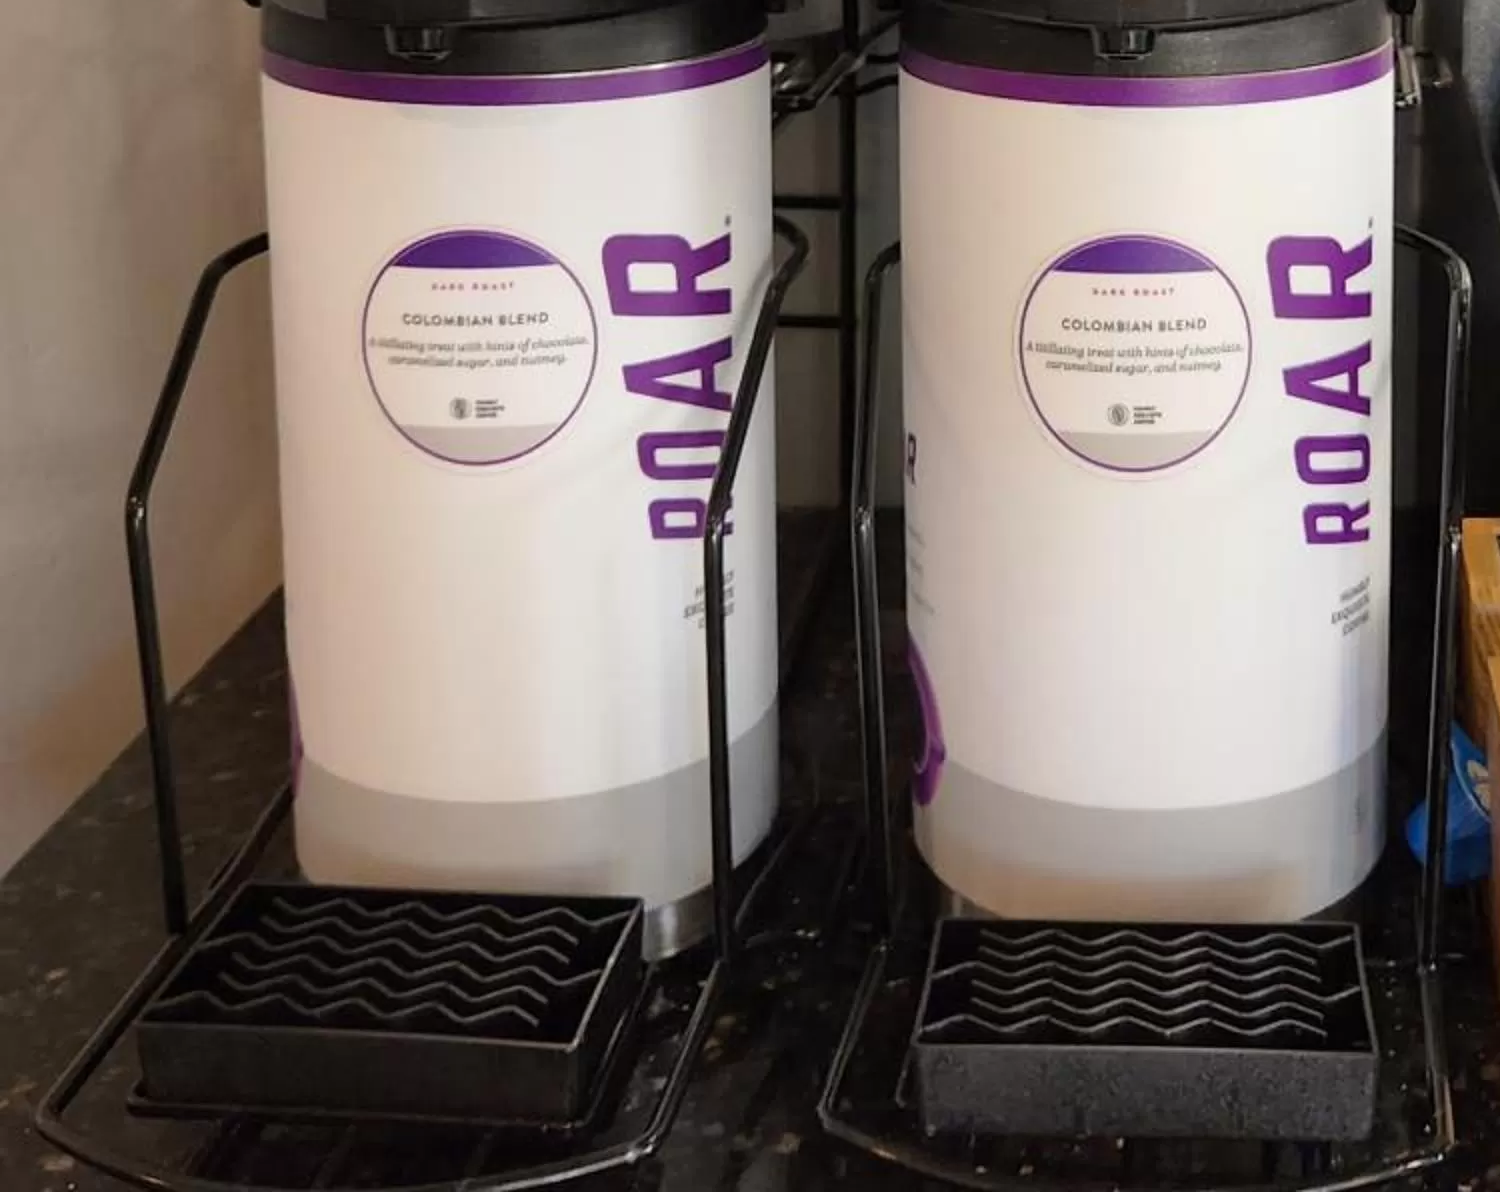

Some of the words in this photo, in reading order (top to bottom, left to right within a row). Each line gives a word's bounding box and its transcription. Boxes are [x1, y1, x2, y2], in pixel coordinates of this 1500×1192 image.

[402, 312, 494, 327] COLOMBIAN
[499, 312, 550, 325] BLEND
[1061, 316, 1153, 333] COLOMBIAN
[1158, 317, 1208, 332] BLEND
[1266, 234, 1372, 545] ROAR
